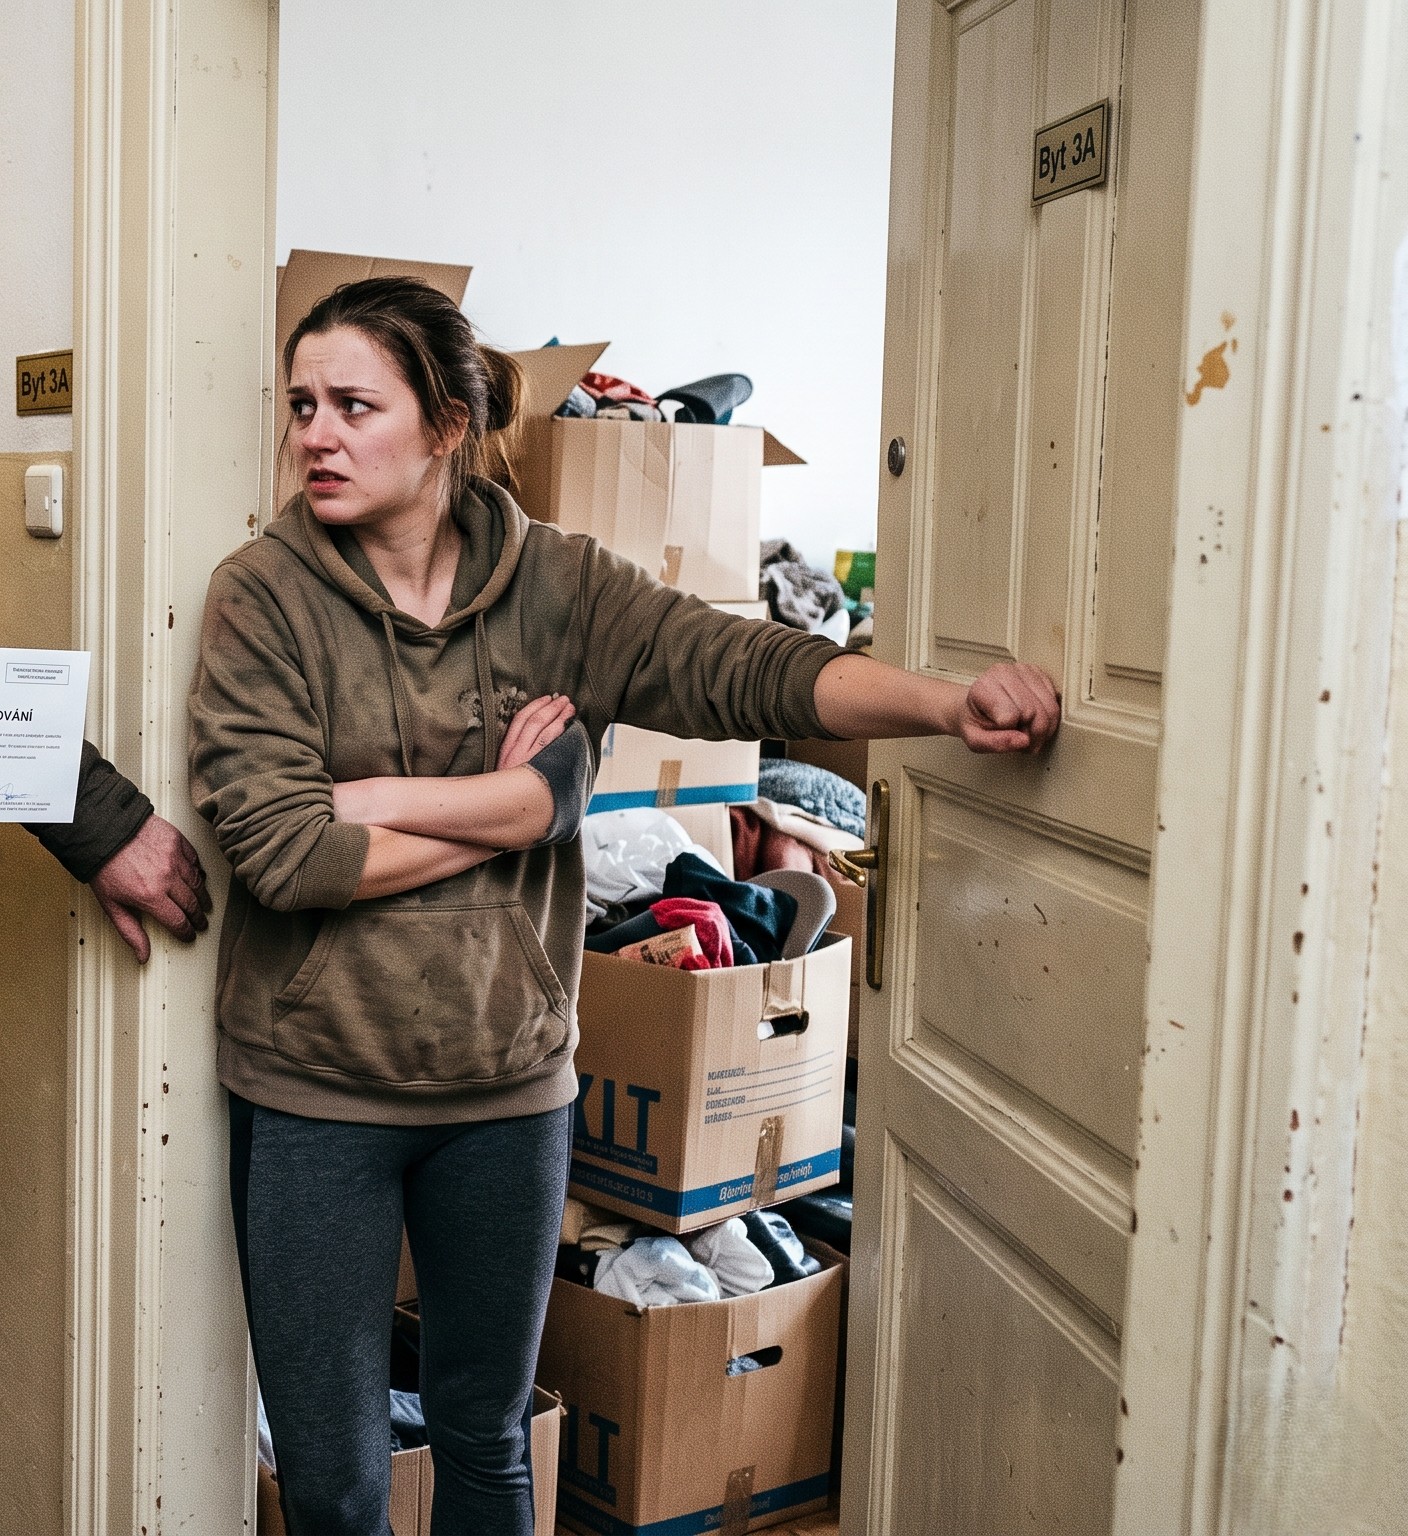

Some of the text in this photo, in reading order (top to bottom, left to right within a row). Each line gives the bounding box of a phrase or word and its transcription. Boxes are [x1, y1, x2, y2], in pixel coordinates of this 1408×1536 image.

[1039, 126, 1096, 184] Byt 3A
[21, 367, 70, 402] Byt 3A
